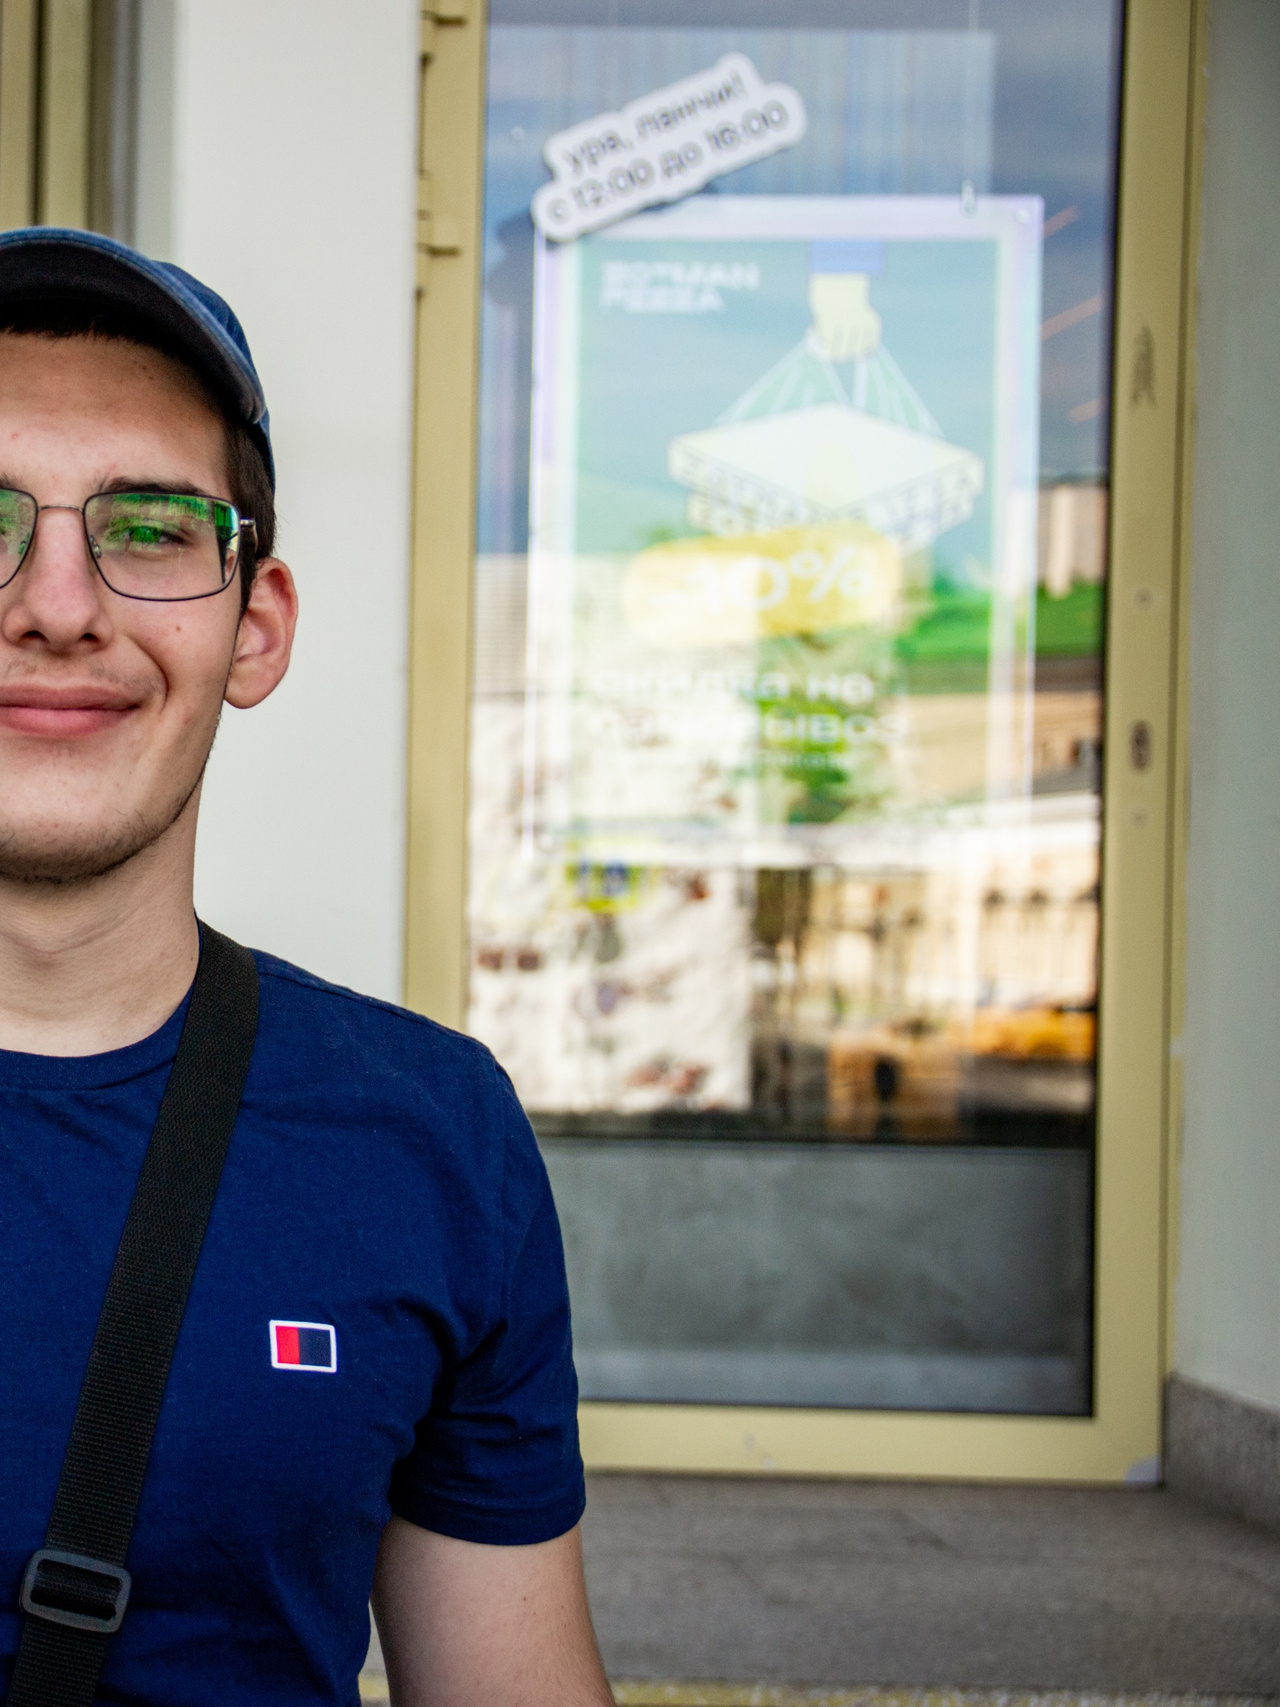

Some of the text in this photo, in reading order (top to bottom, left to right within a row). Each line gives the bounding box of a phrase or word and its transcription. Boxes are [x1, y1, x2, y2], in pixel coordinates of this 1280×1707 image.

[571, 158, 655, 212] 12:00
[659, 141, 703, 181] до
[704, 100, 788, 154] 16:00
